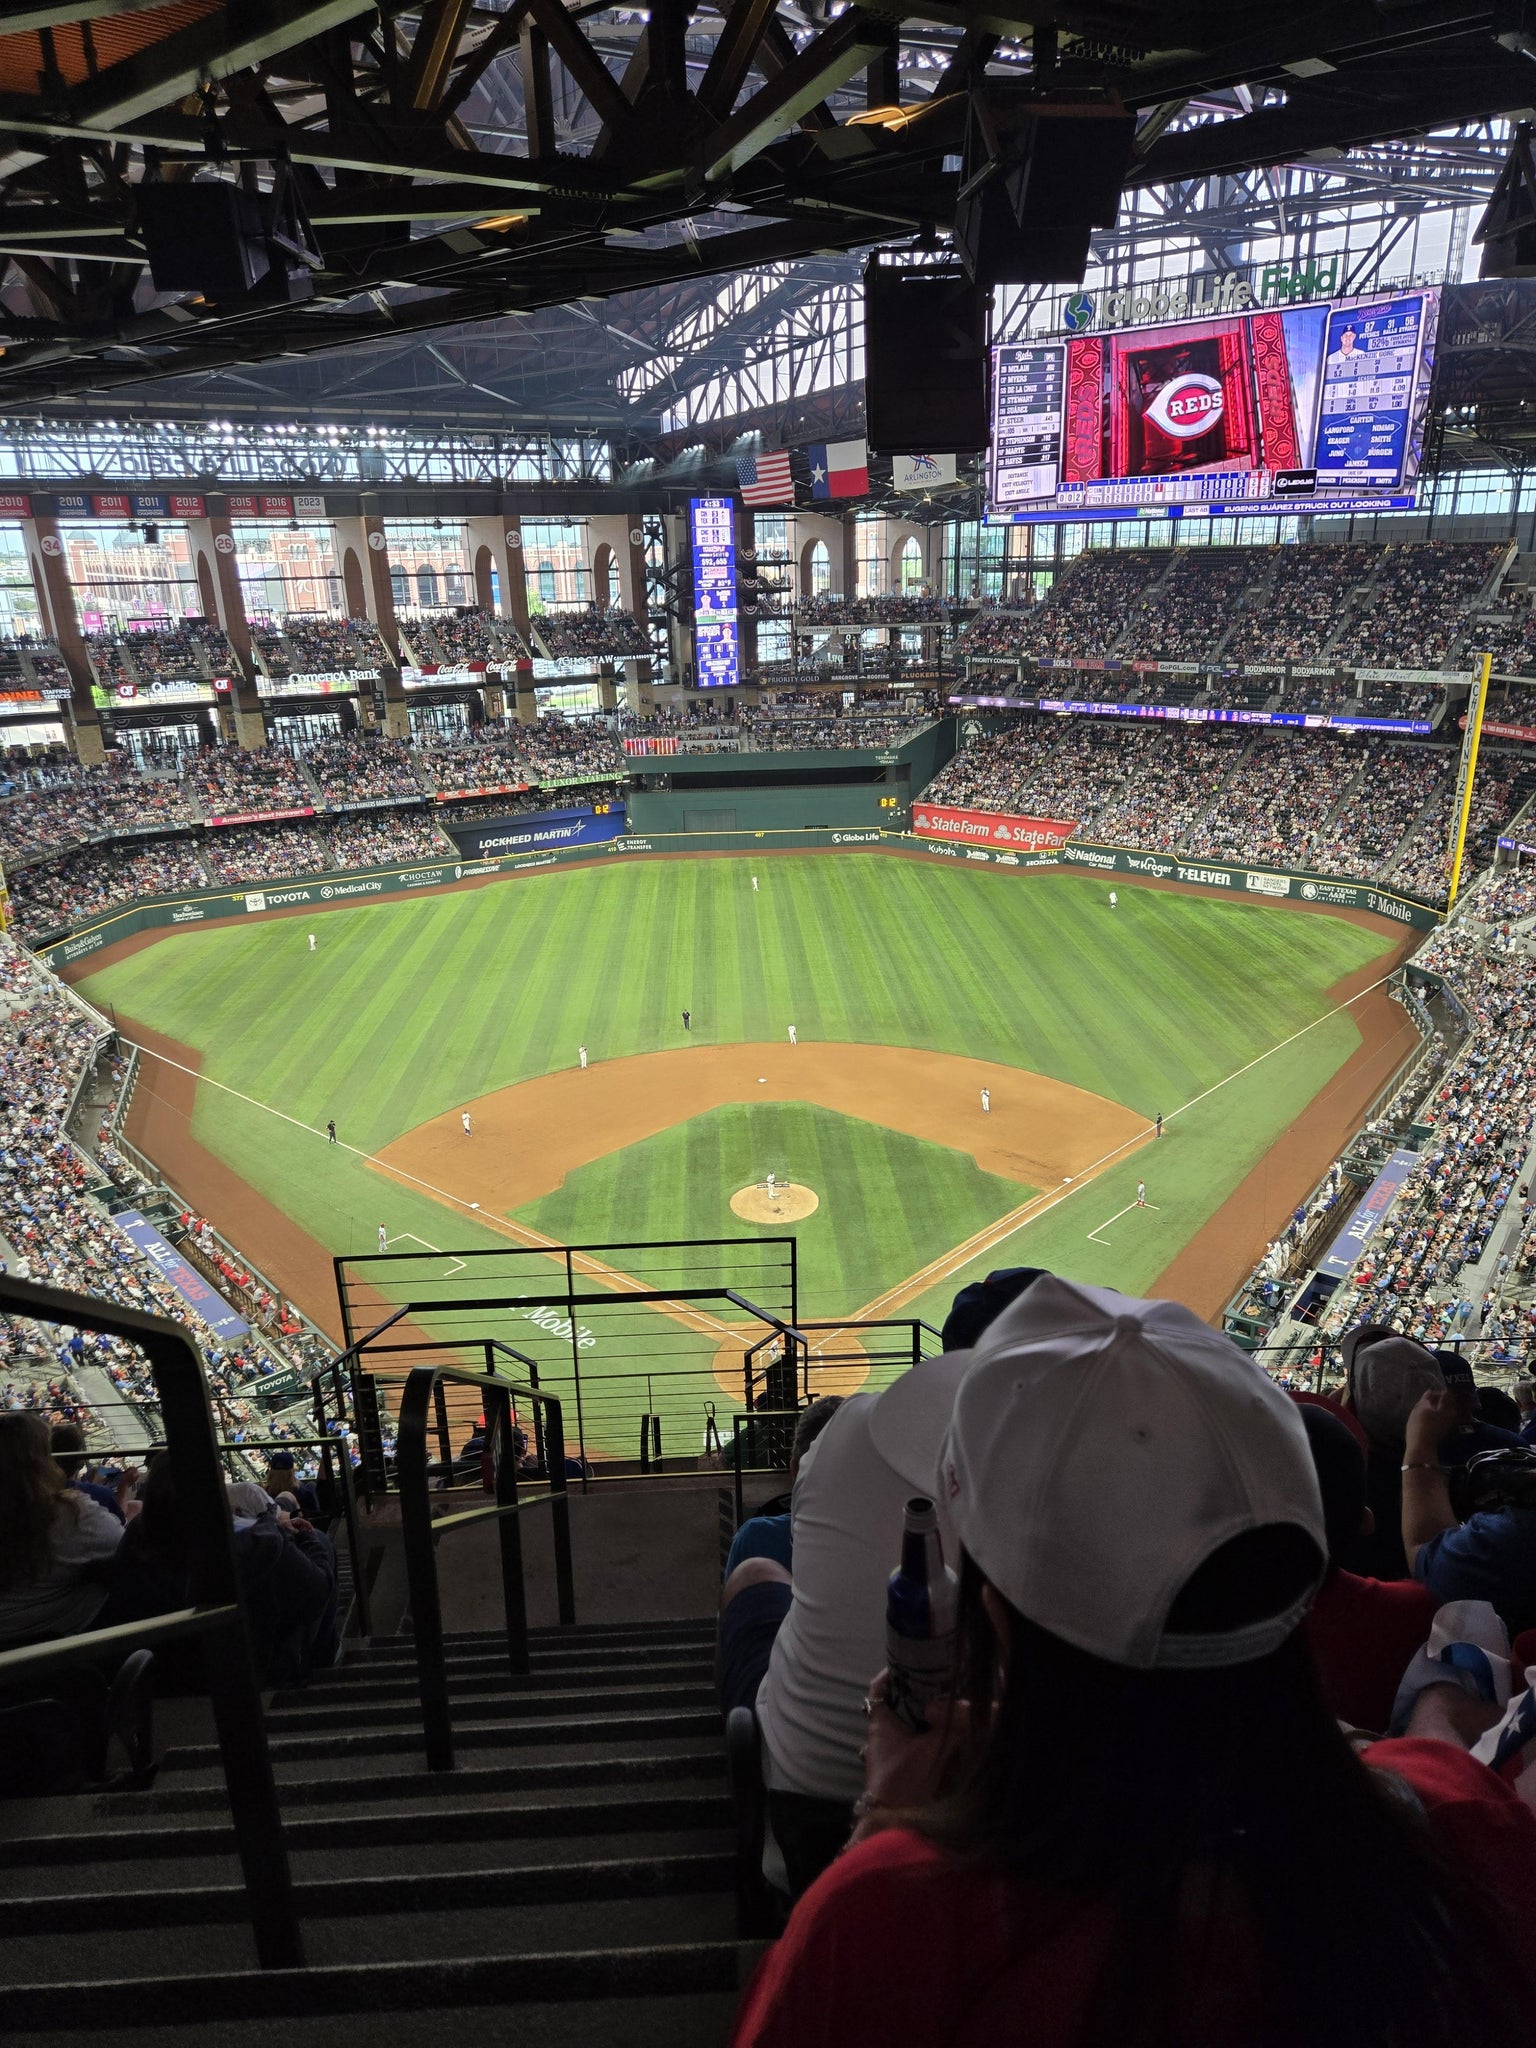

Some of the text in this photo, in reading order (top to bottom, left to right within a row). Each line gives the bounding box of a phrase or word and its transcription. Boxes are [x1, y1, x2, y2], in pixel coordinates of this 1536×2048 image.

[1102, 257, 1338, 323] Globe Life Field
[1365, 321, 1375, 332] 87
[1387, 319, 1395, 329] 31
[1383, 327, 1397, 335] BALLS
[1372, 338, 1389, 348] 52%
[1015, 349, 1033, 361] Reds
[1345, 351, 1377, 361] MacKENZIE
[1008, 375, 1027, 383] MYERS
[1023, 385, 1037, 393] CRUZ
[1007, 396, 1033, 404] STEWART
[1171, 391, 1223, 417] REDS
[1324, 426, 1355, 434] LANGFORD
[1371, 435, 1391, 443] SMITH
[1005, 447, 1025, 455] MARTE
[1005, 457, 1023, 465] HAYES
[904, 470, 942, 482] ARLINGTON
[1288, 478, 1314, 486] LEXUS
[0, 497, 23, 506] 2010
[59, 497, 84, 506] 2010
[101, 497, 122, 507] 2011
[138, 497, 159, 507] 2011
[176, 497, 199, 507] 2012
[230, 497, 252, 507] 2015
[266, 497, 287, 507] 2016
[298, 497, 320, 507] 2023
[1224, 500, 1391, 513] EUGENIO SUÁREZ STRUCK OUT LOOKING
[373, 536, 381, 547] 7
[508, 534, 520, 545] 29
[632, 533, 641, 543] 10
[44, 541, 59, 551] 34
[217, 538, 231, 549] 26
[560, 654, 614, 666] CHOCTAW
[1053, 659, 1072, 667] 105.3
[1138, 663, 1156, 671] PGL
[1159, 664, 1197, 672] GoPGL.com
[1206, 665, 1223, 673] PGL
[1244, 665, 1286, 674] BODYARMOR
[1292, 666, 1335, 676] BODYARMOR
[348, 668, 381, 681] Bank
[1357, 670, 1380, 679] Blue
[1384, 671, 1412, 680] Mint
[152, 681, 198, 693] QuikTrip
[215, 680, 228, 690] QT
[120, 685, 134, 696] QT
[547, 772, 622, 788] LUXOR STAFFING
[1458, 772, 1467, 791] IZ
[357, 801, 375, 809] RANGERS
[376, 799, 395, 807] BASEBALL
[222, 813, 257, 823] America's
[275, 809, 305, 818] Network
[135, 826, 160, 834] American
[931, 816, 990, 837] StateFarm
[479, 828, 571, 849] LOCKHEED MARTIN
[842, 833, 879, 842] Globe Life
[1012, 827, 1066, 847] StateFar
[928, 844, 957, 857] Kubota
[1076, 849, 1116, 865] National
[1026, 858, 1059, 867] HONDA
[1140, 857, 1173, 878] Kroger
[402, 869, 443, 882] CHOCTAW
[462, 865, 501, 876] PROGRESSIVE
[1249, 875, 1259, 887] T
[334, 882, 383, 895] Medical City
[1336, 887, 1357, 895] TEXAS
[267, 891, 310, 905] TOYOTA
[1317, 896, 1356, 904] UNIVERSITY
[172, 910, 204, 919] Budweiser
[66, 948, 88, 960] ATTORNEYS
[1348, 1180, 1396, 1240] ALL for TEXAS
[125, 1219, 145, 1230] T
[1328, 1255, 1349, 1267] T
[144, 1242, 209, 1300] ALL for TEXAS
[522, 1306, 596, 1349] Mobile
[258, 1374, 292, 1391] TOYOTA
